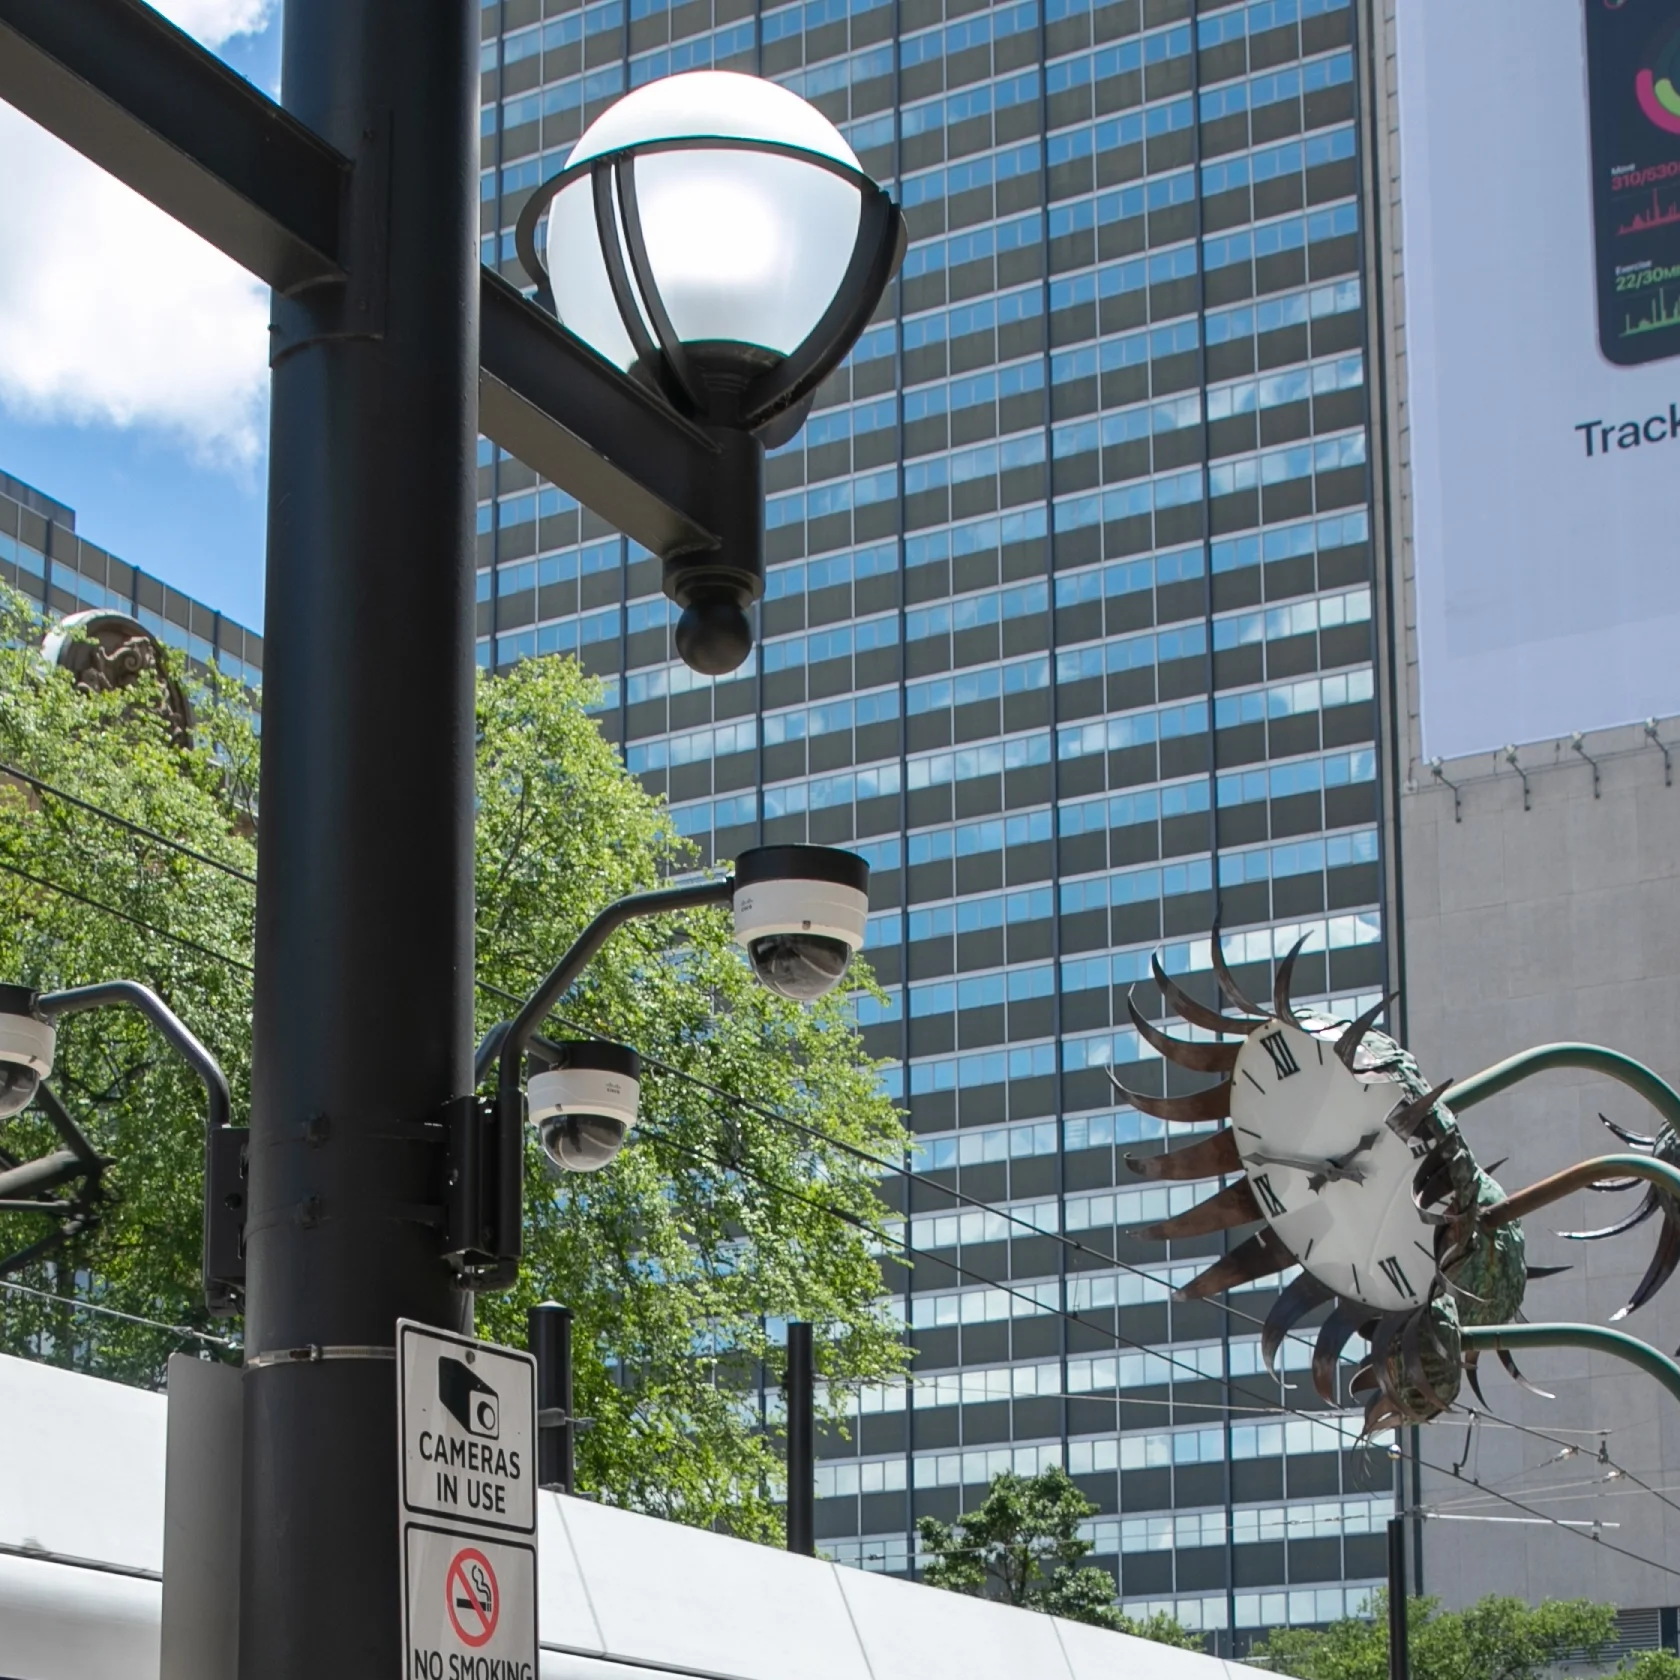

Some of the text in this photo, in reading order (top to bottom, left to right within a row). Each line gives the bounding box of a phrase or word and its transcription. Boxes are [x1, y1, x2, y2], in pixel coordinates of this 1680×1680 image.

[418, 1430, 521, 1480] CAMERAS
[436, 1471, 506, 1514] IN USE
